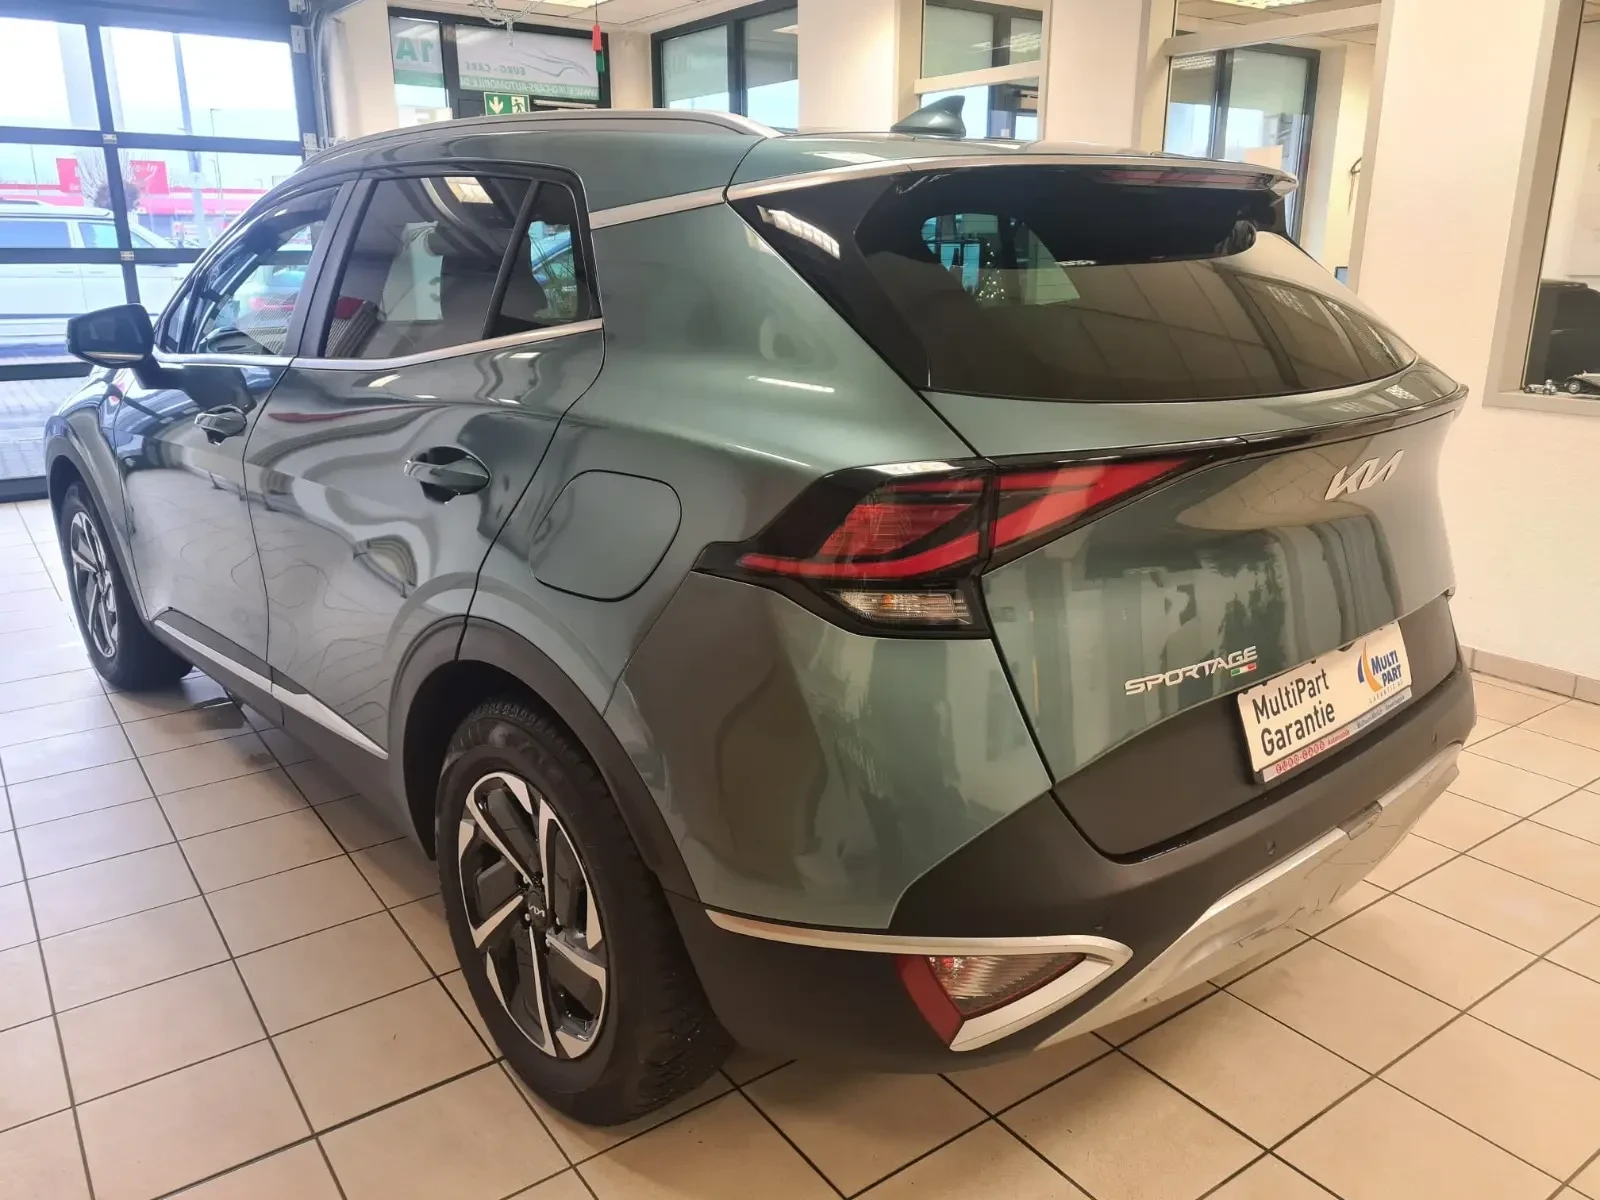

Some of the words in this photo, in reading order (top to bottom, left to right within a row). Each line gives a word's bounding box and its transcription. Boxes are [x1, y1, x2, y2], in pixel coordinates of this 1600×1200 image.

[1325, 449, 1404, 500] KIA
[1124, 645, 1258, 696] SPORTAGE
[1381, 664, 1402, 687] PART
[1252, 668, 1330, 725] MultiPart
[1261, 703, 1336, 757] Garantie
